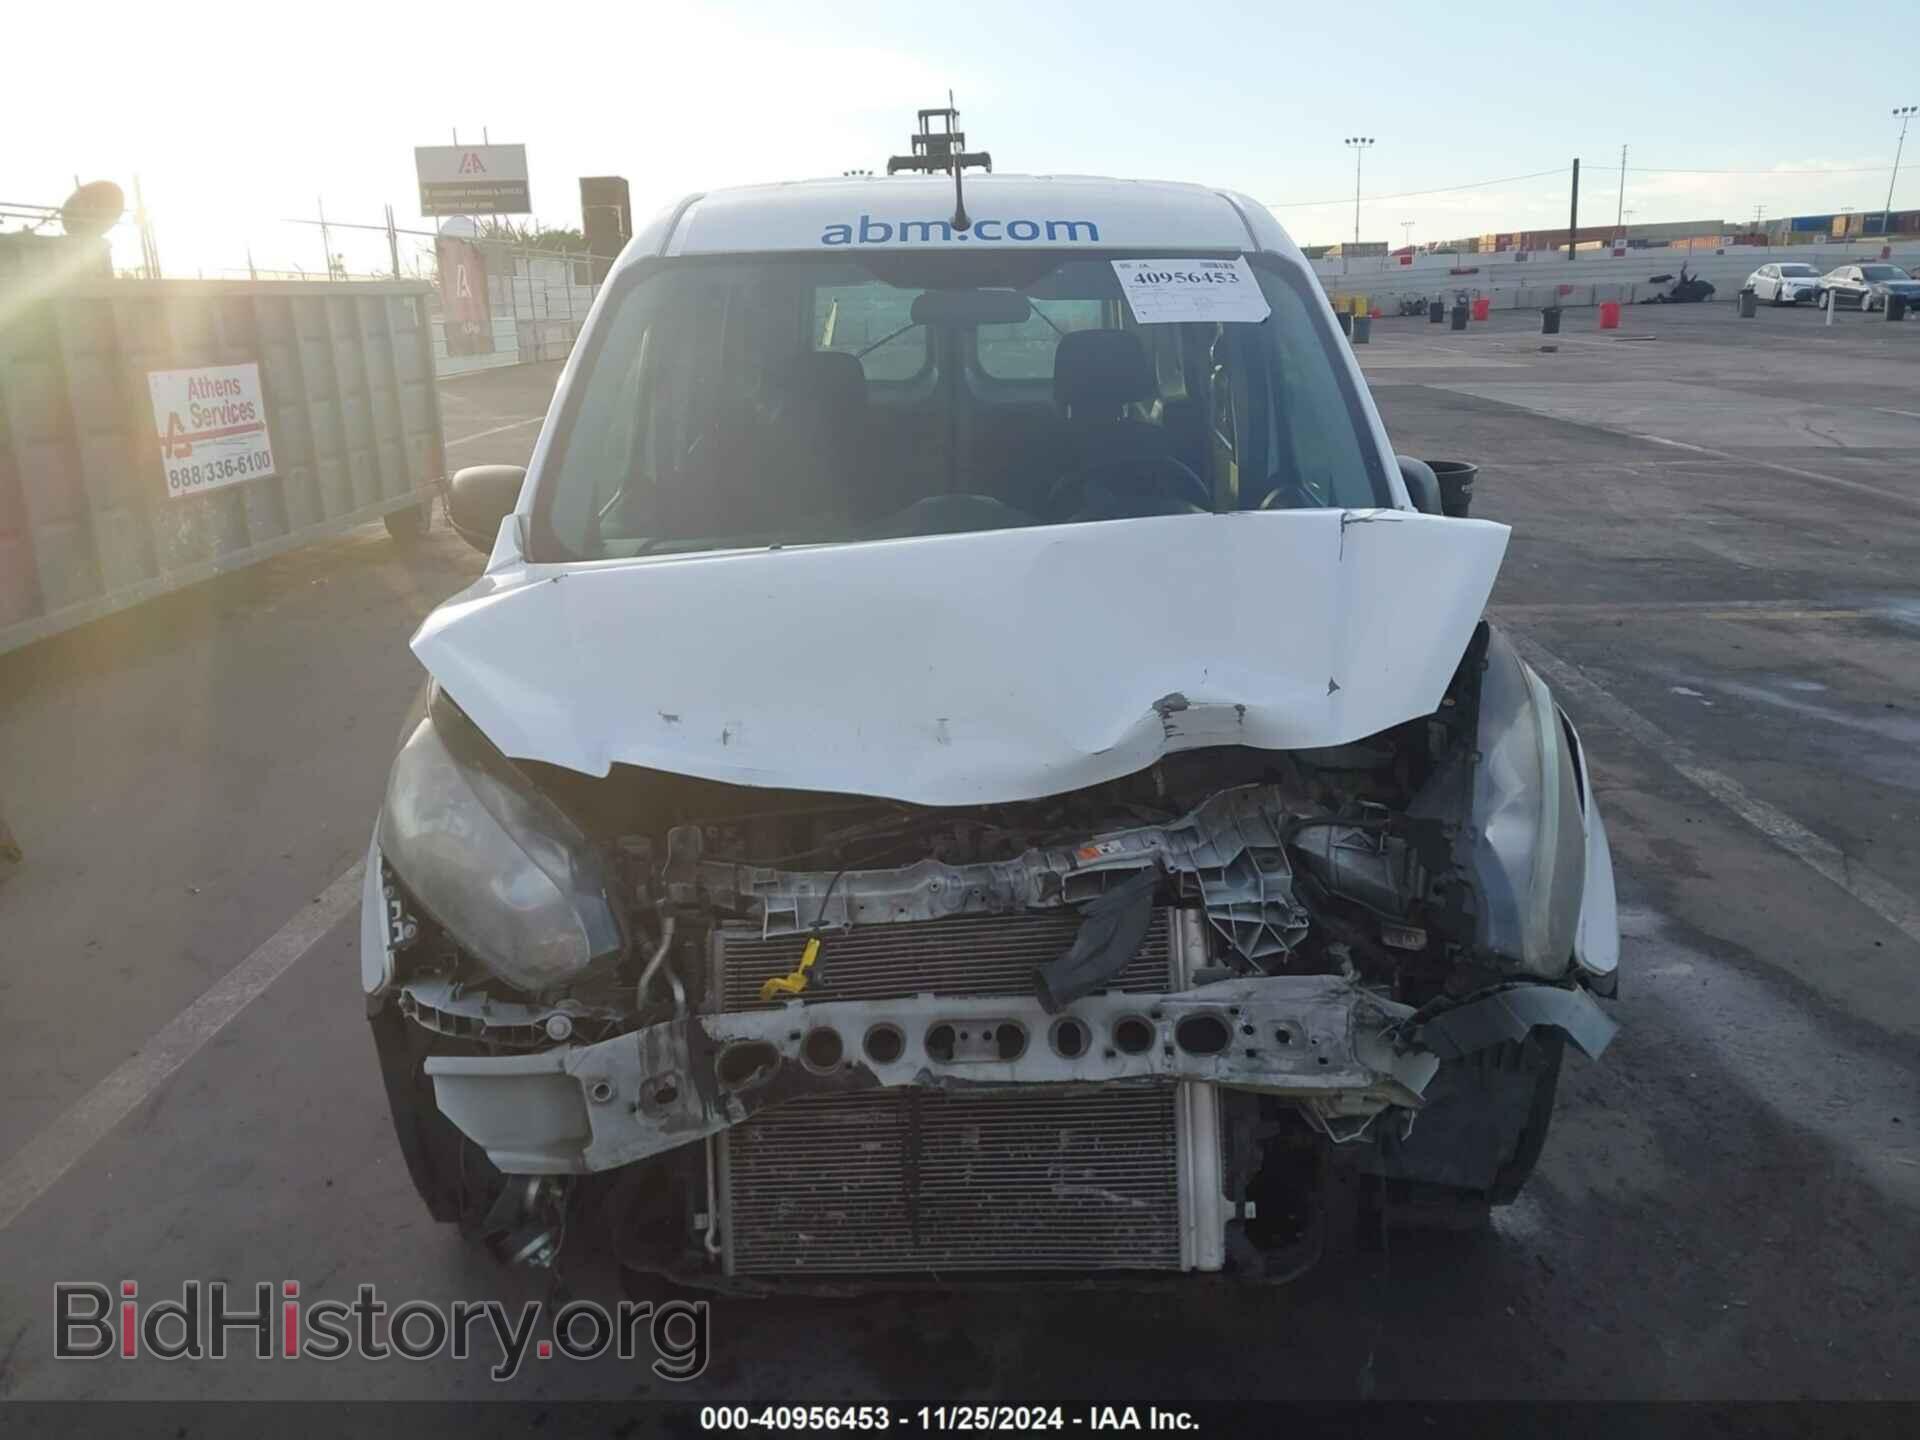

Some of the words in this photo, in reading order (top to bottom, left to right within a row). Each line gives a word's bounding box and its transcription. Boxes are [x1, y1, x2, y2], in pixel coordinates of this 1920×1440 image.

[821, 215, 1099, 245] abm.com
[1134, 271, 1240, 284] 40956453
[188, 376, 241, 400] Athens
[190, 400, 256, 428] Services
